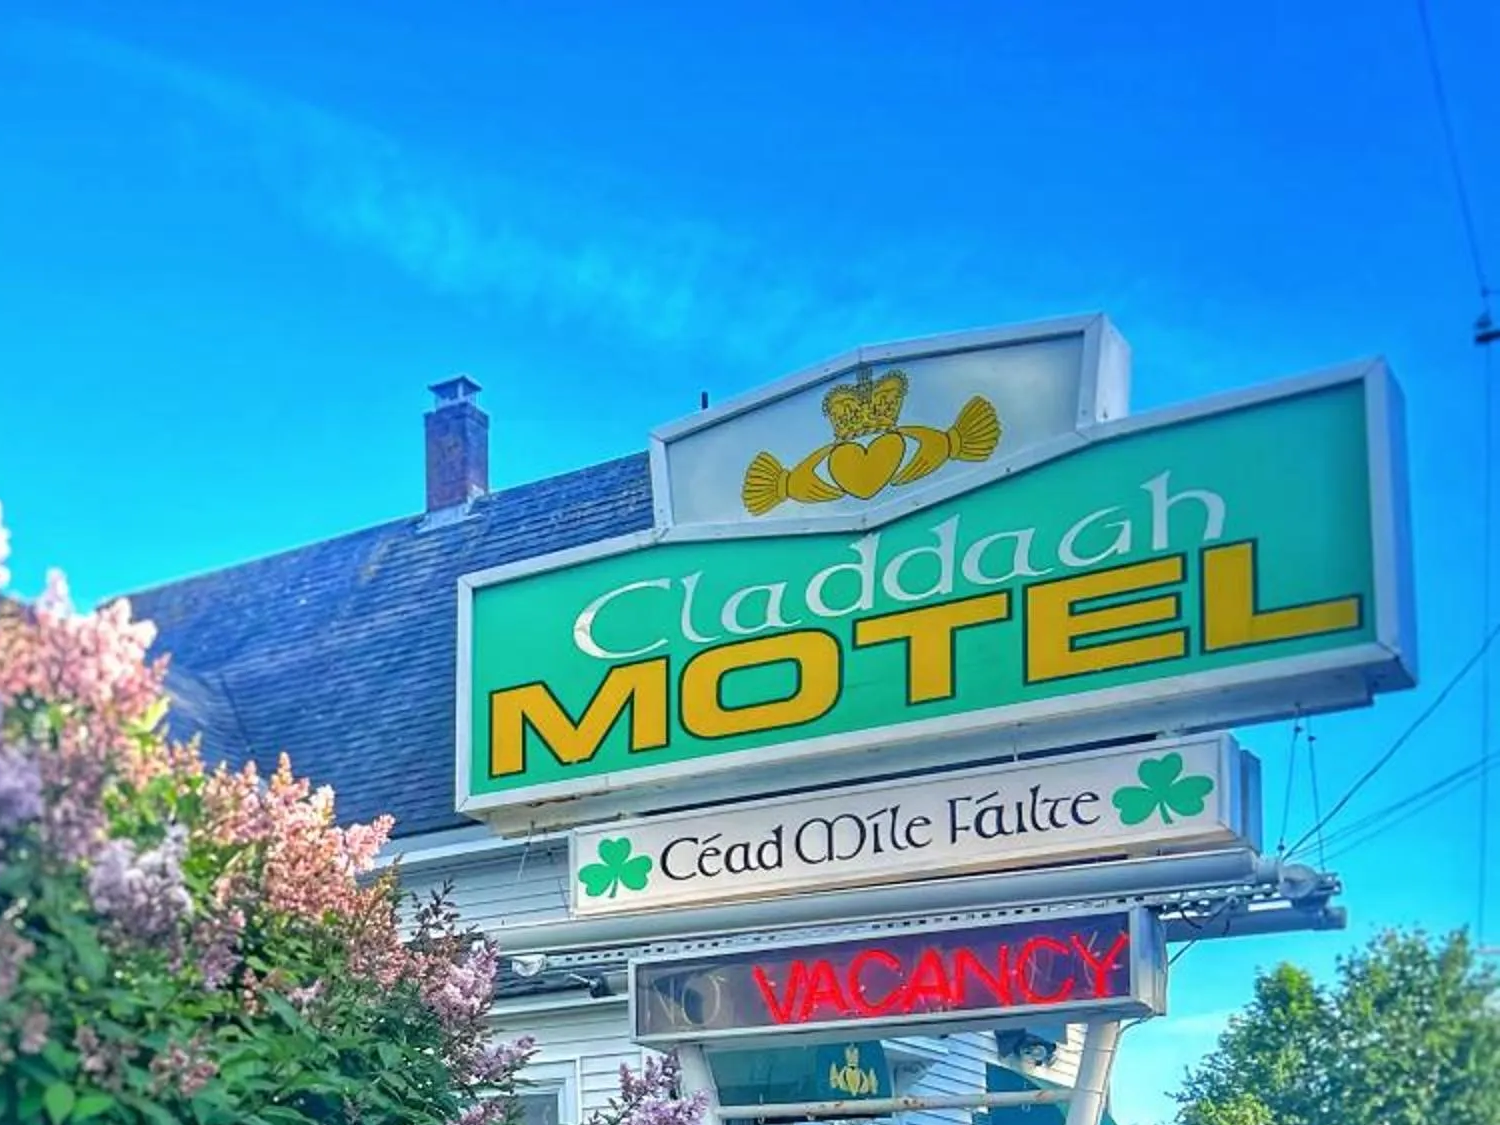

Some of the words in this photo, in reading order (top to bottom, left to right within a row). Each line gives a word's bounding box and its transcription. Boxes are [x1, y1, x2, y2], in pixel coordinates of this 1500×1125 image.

[573, 469, 1227, 661] Claddagh
[487, 540, 1363, 778] MOTEL
[660, 824, 784, 881] Céad
[794, 804, 932, 864] Míle
[948, 785, 1102, 844] Fáilte
[655, 974, 725, 1026] NO
[751, 931, 1130, 1025] VACANCY
